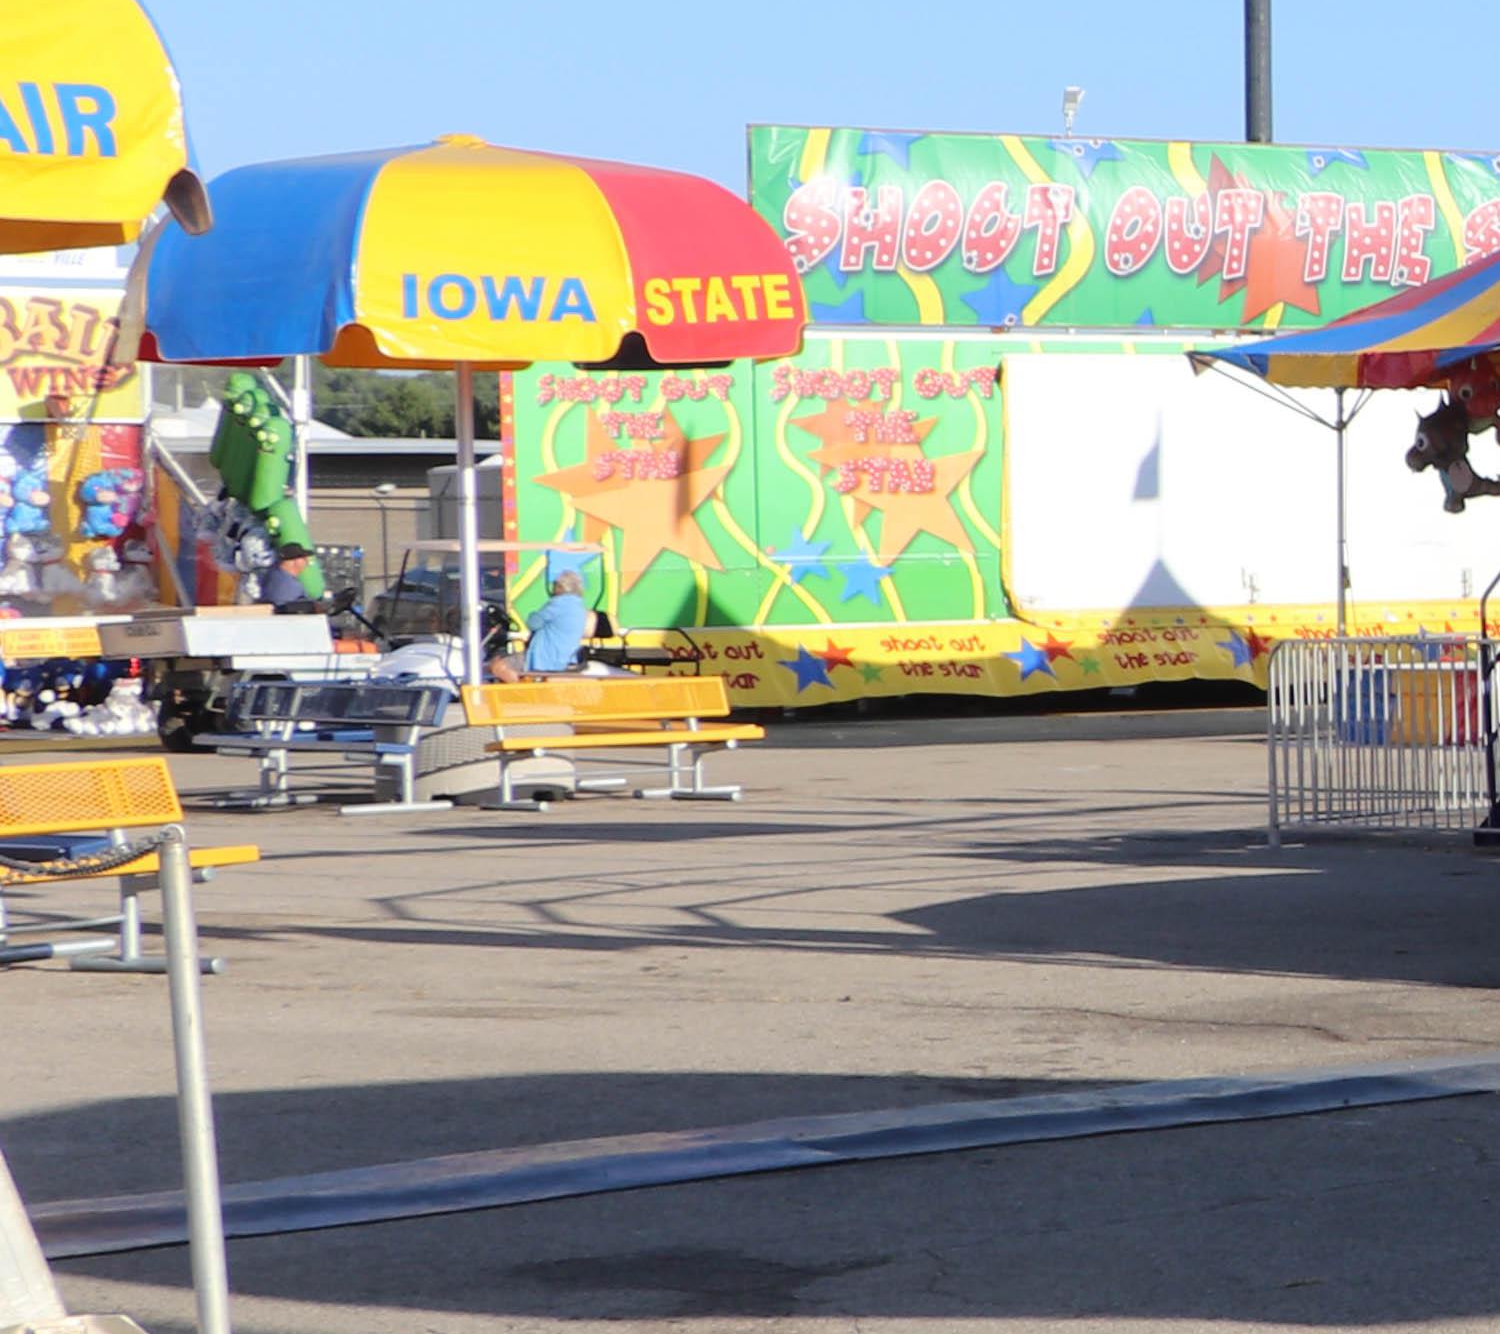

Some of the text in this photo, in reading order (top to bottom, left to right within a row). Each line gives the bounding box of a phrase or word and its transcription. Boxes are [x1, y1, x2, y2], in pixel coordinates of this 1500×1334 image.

[784, 180, 1074, 275] SHOOT
[1105, 186, 1263, 280] OUT
[1296, 192, 1435, 287] THE
[402, 274, 597, 323] IOWA
[643, 274, 794, 326] STATE
[660, 373, 734, 402] OUT
[769, 364, 998, 404] SHOOT OUT
[844, 410, 919, 444] THE
[724, 640, 764, 660] out
[880, 634, 985, 654] shoot out
[899, 658, 984, 679] the star
